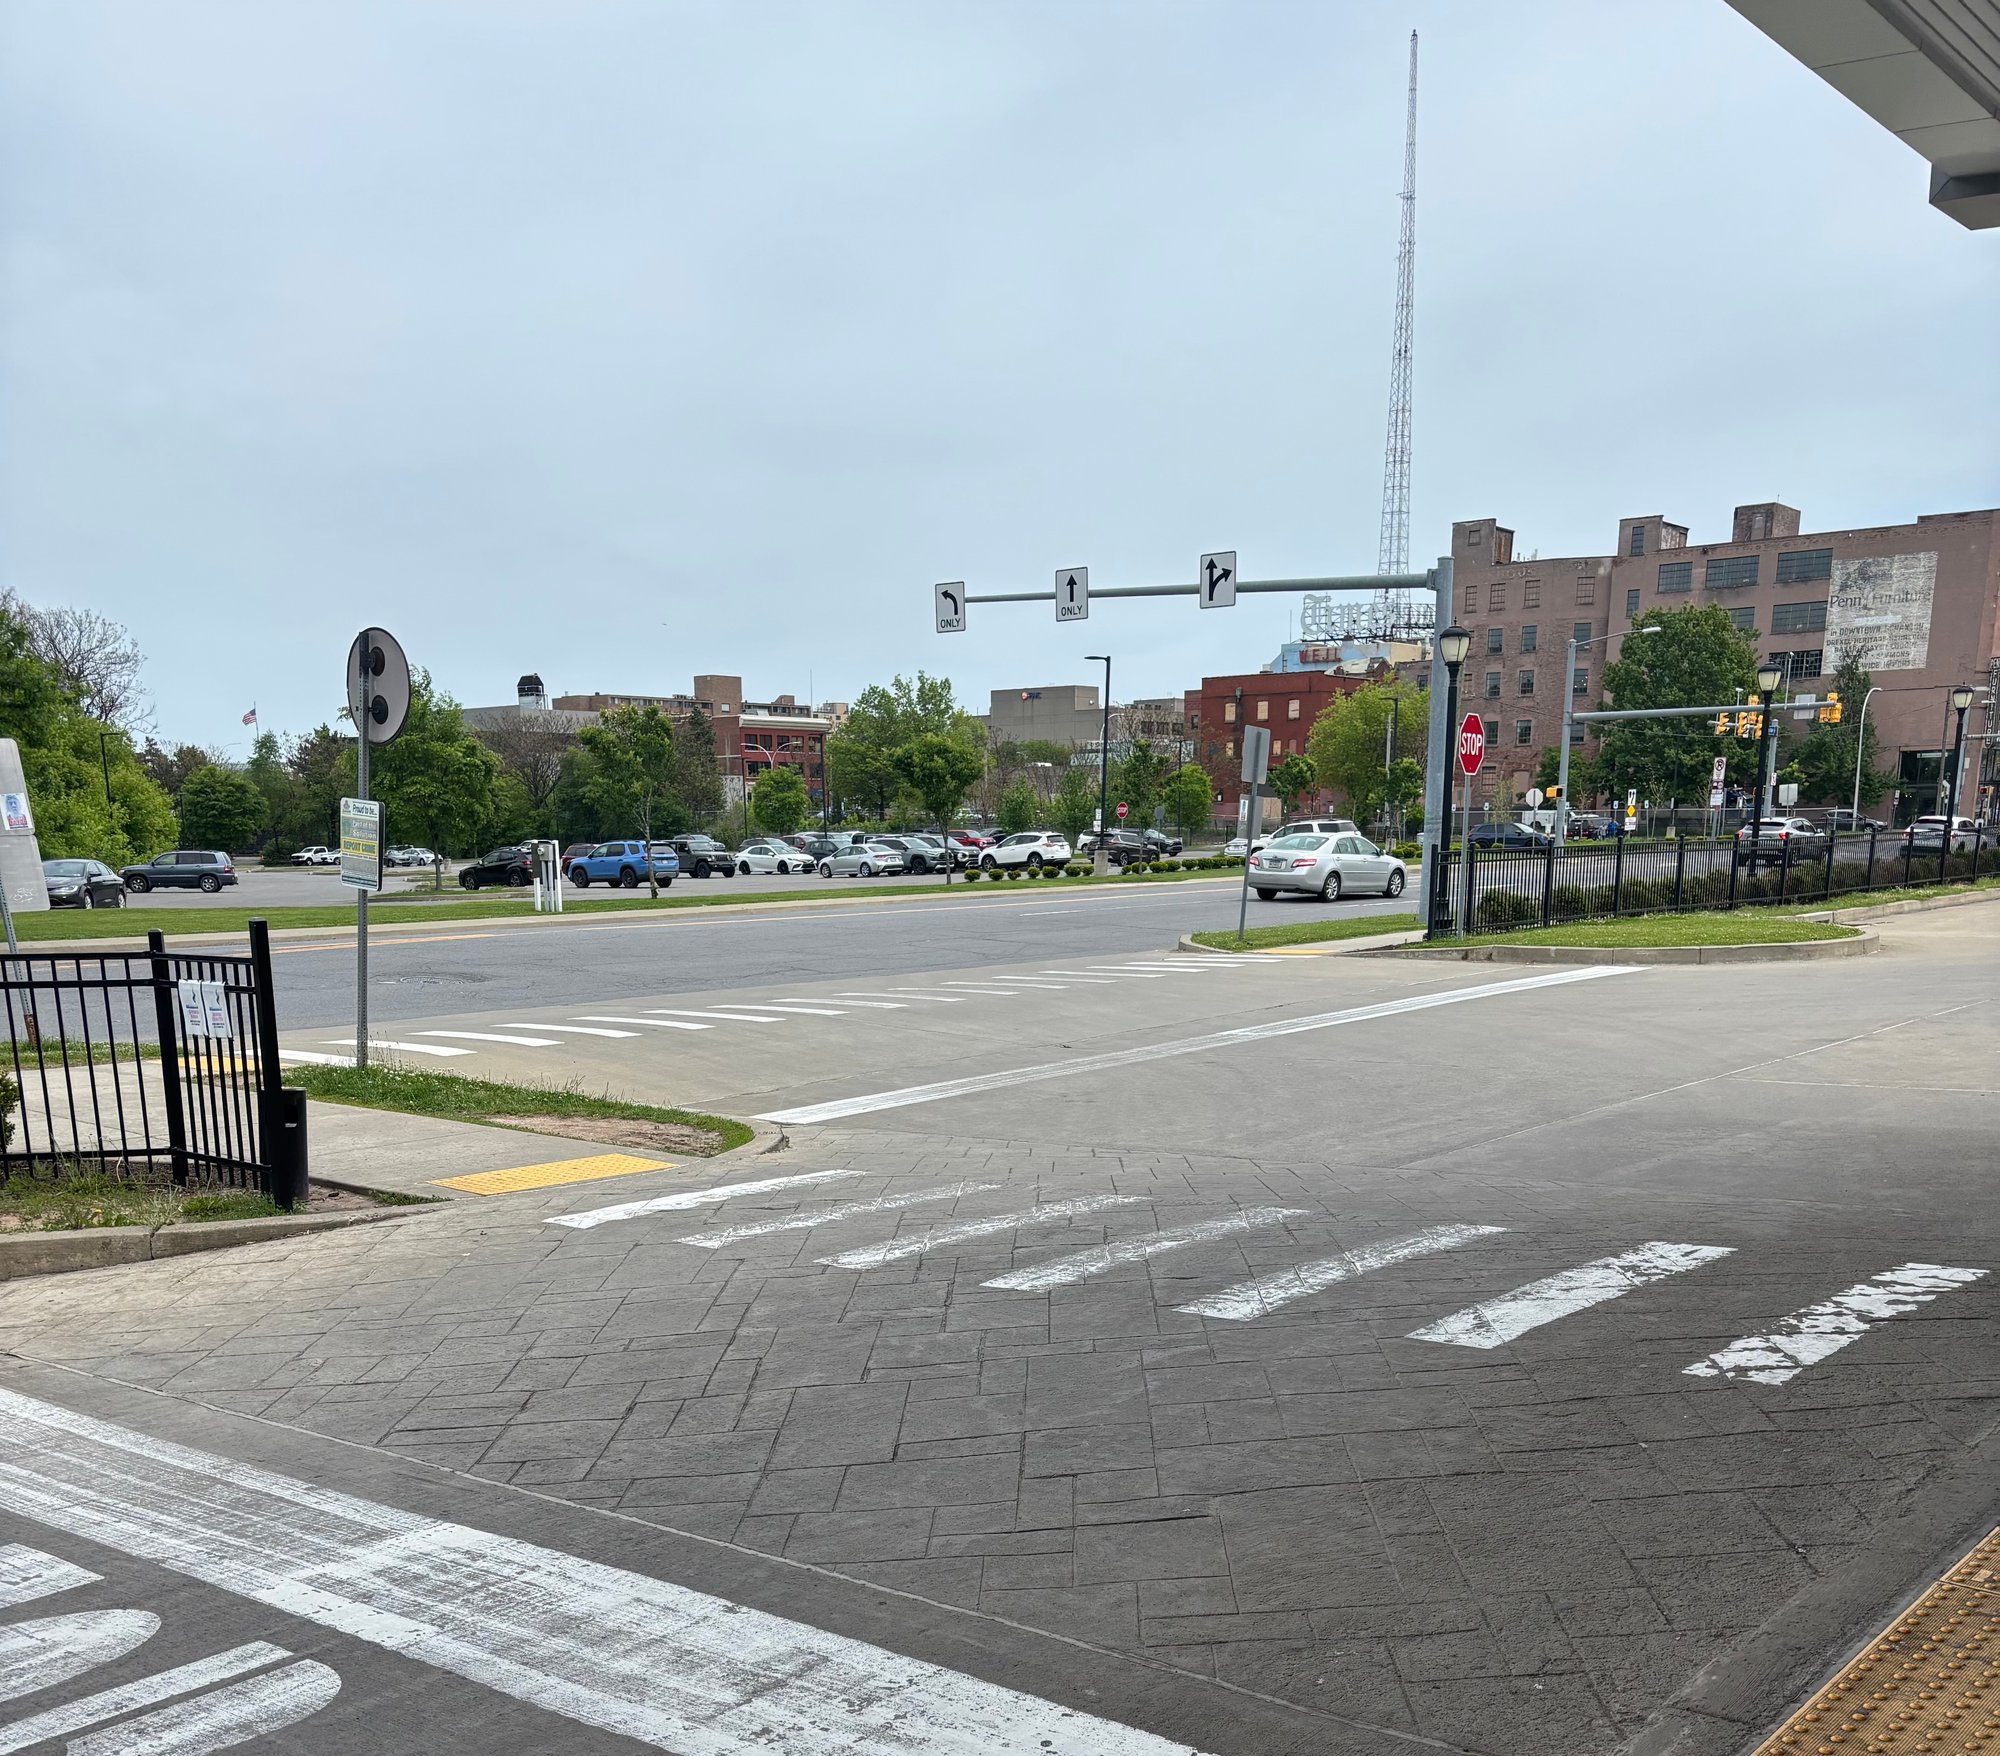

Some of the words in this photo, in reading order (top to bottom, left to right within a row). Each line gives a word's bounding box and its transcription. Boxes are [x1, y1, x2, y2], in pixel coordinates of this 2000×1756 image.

[1829, 595, 1862, 608] Penn
[1060, 605, 1082, 617] ONLY
[940, 618, 961, 629] ONLY
[1839, 625, 1881, 636] DOWNTOWN
[1460, 732, 1483, 755] STOP
[352, 803, 364, 814] Proud
